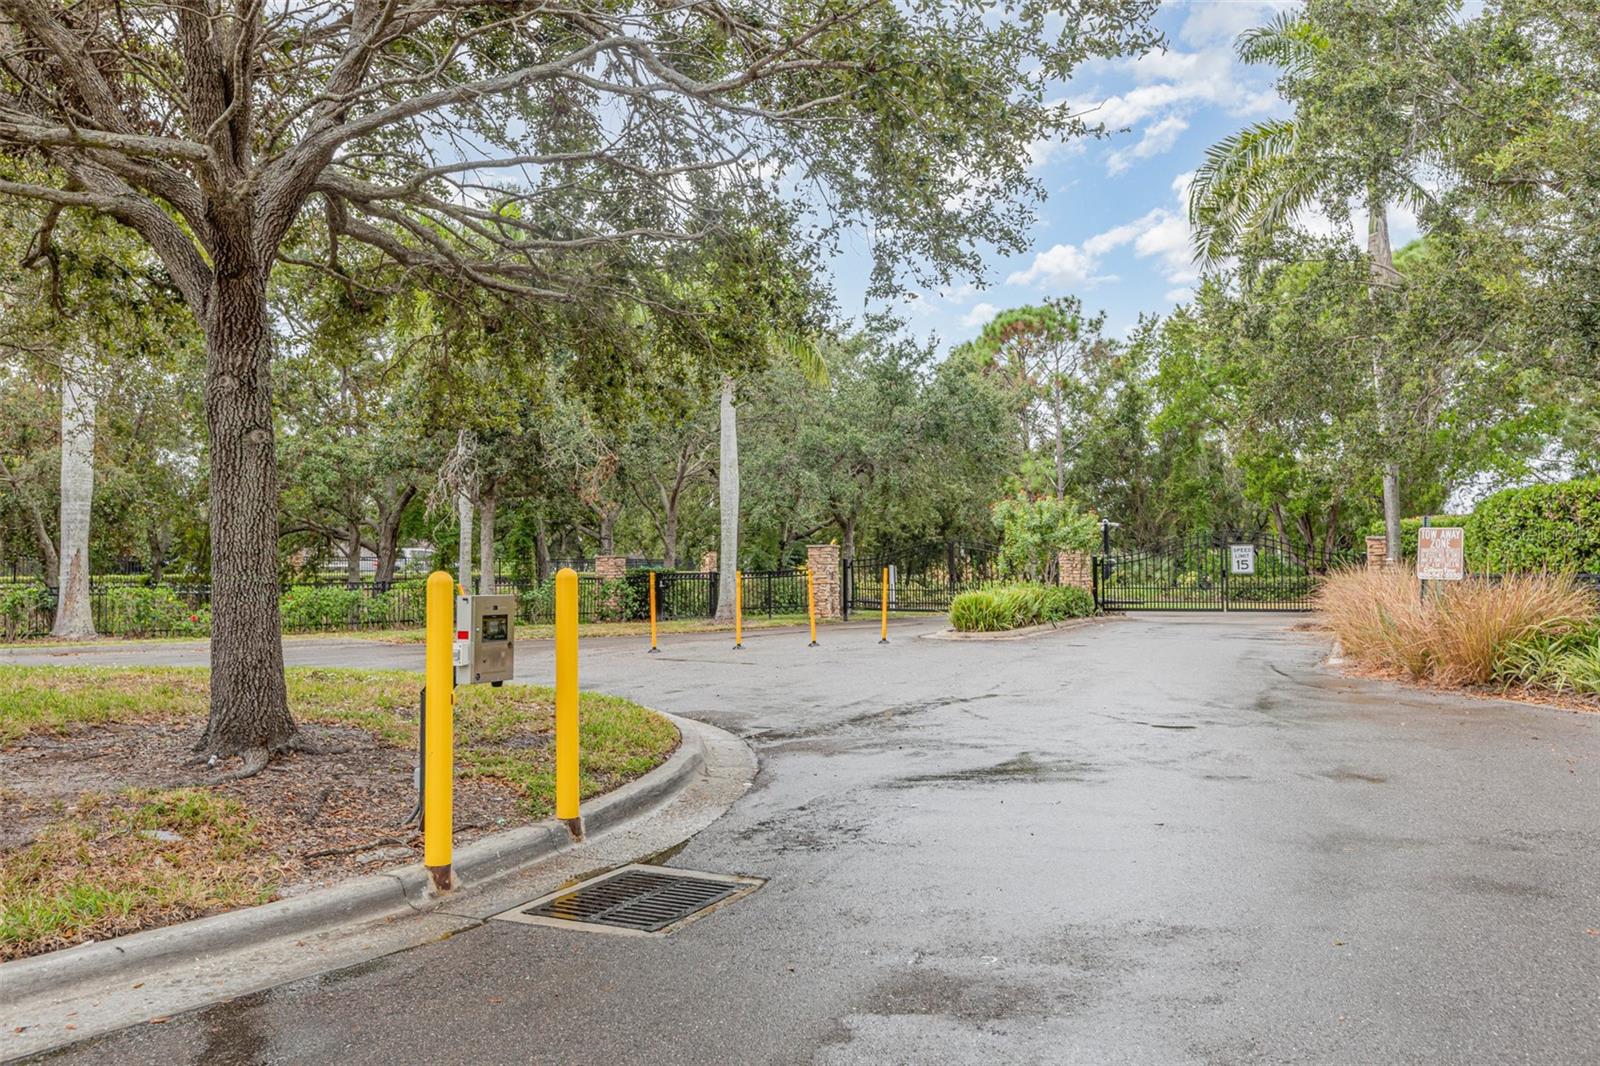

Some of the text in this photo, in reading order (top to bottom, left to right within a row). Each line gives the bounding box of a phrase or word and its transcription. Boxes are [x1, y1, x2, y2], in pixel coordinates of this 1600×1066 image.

[1421, 529, 1460, 539] TOW AWAY
[1431, 539, 1450, 548] ZONE
[1236, 560, 1249, 570] 15
